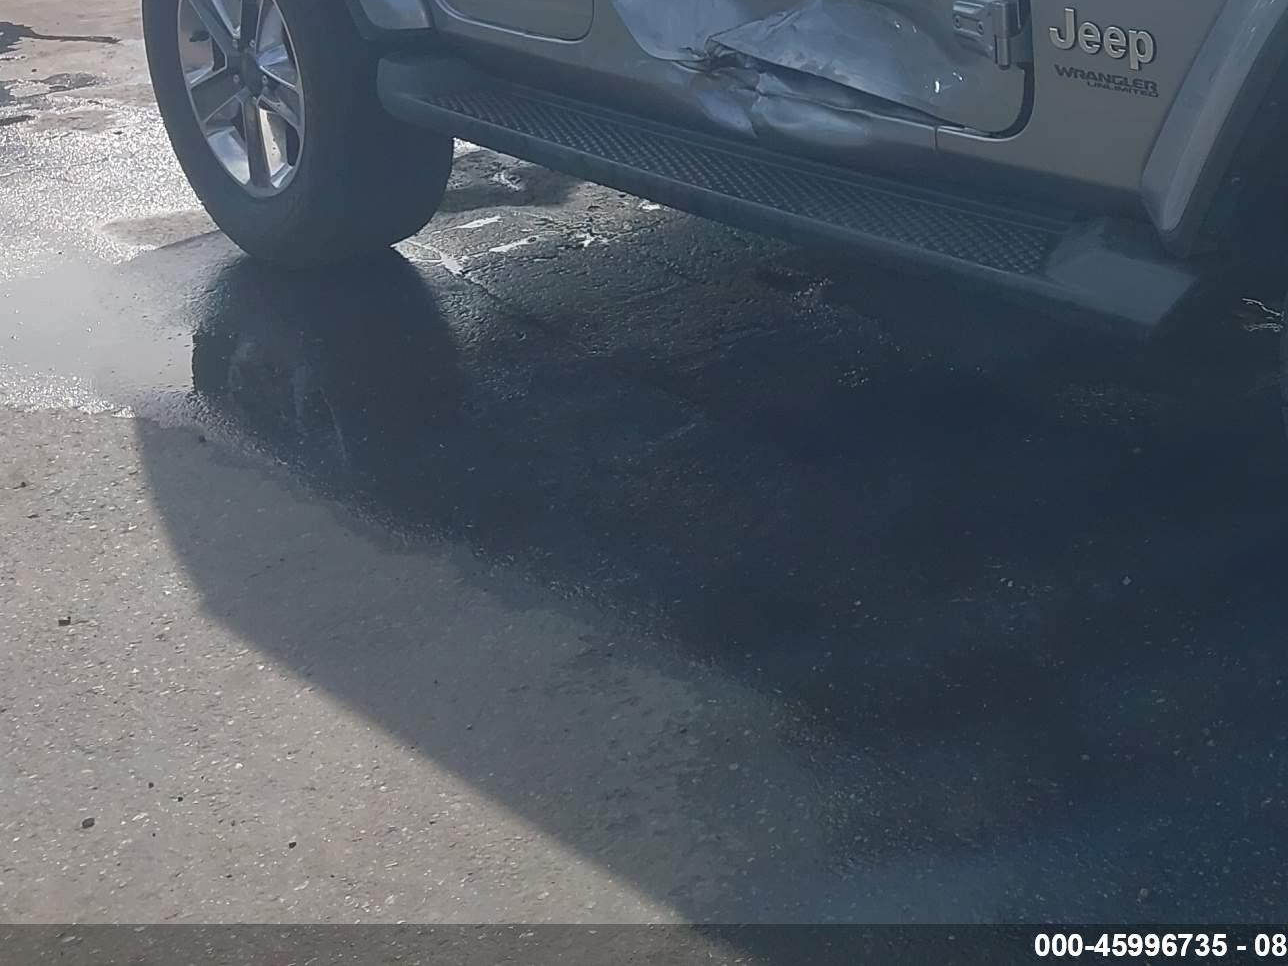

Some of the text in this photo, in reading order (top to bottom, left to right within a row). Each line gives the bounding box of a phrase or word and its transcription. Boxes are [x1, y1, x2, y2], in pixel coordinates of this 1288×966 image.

[1048, 7, 1157, 72] Jeep
[1054, 64, 1159, 91] WRANGLER
[1087, 80, 1160, 98] UNLIMITED
